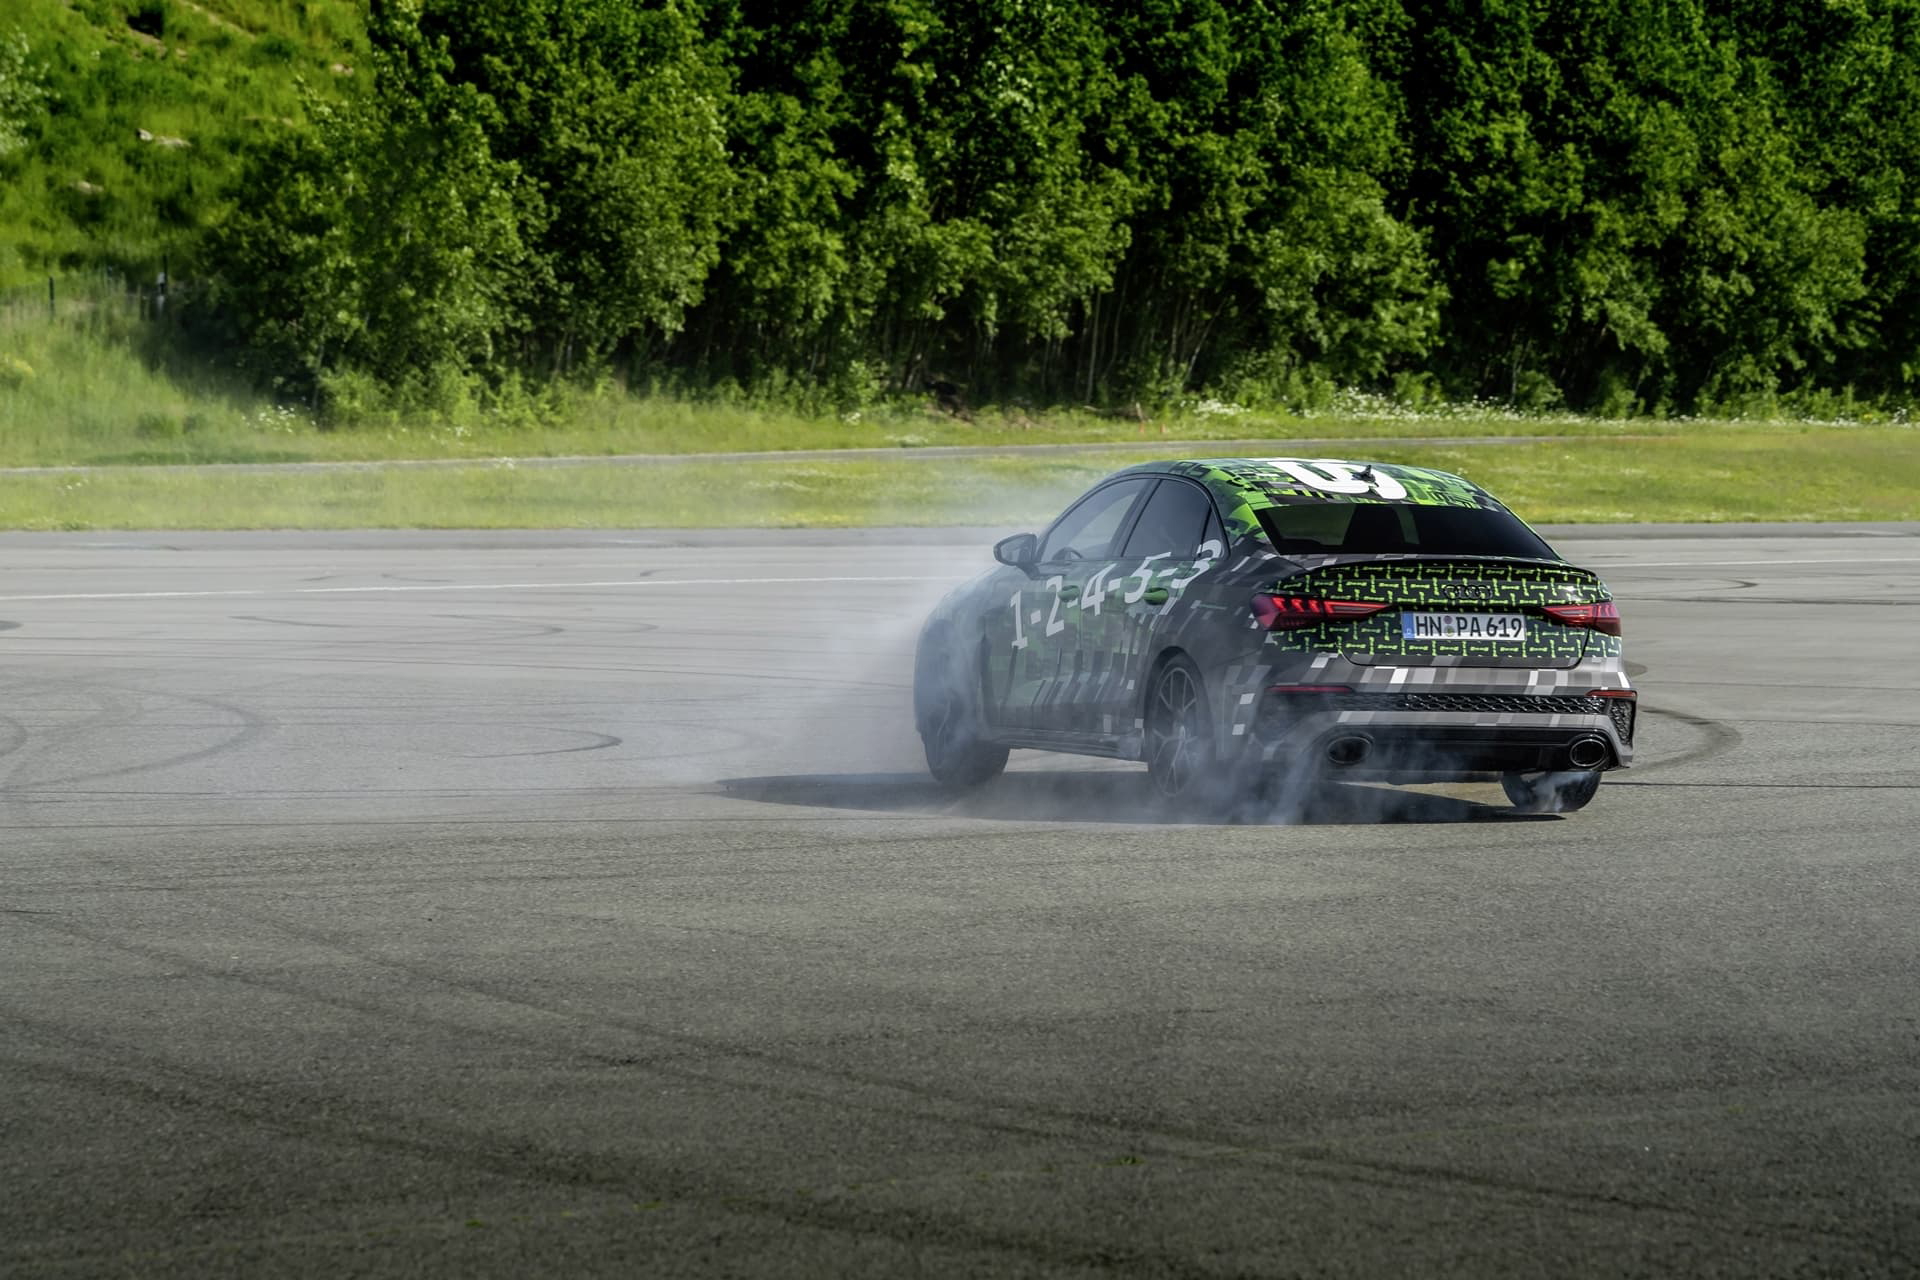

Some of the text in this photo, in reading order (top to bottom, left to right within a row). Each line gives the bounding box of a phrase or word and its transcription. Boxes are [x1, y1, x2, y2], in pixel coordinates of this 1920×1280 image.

[1415, 616, 1442, 636] HN
[1455, 616, 1481, 637] PA
[1486, 617, 1522, 638] 619
